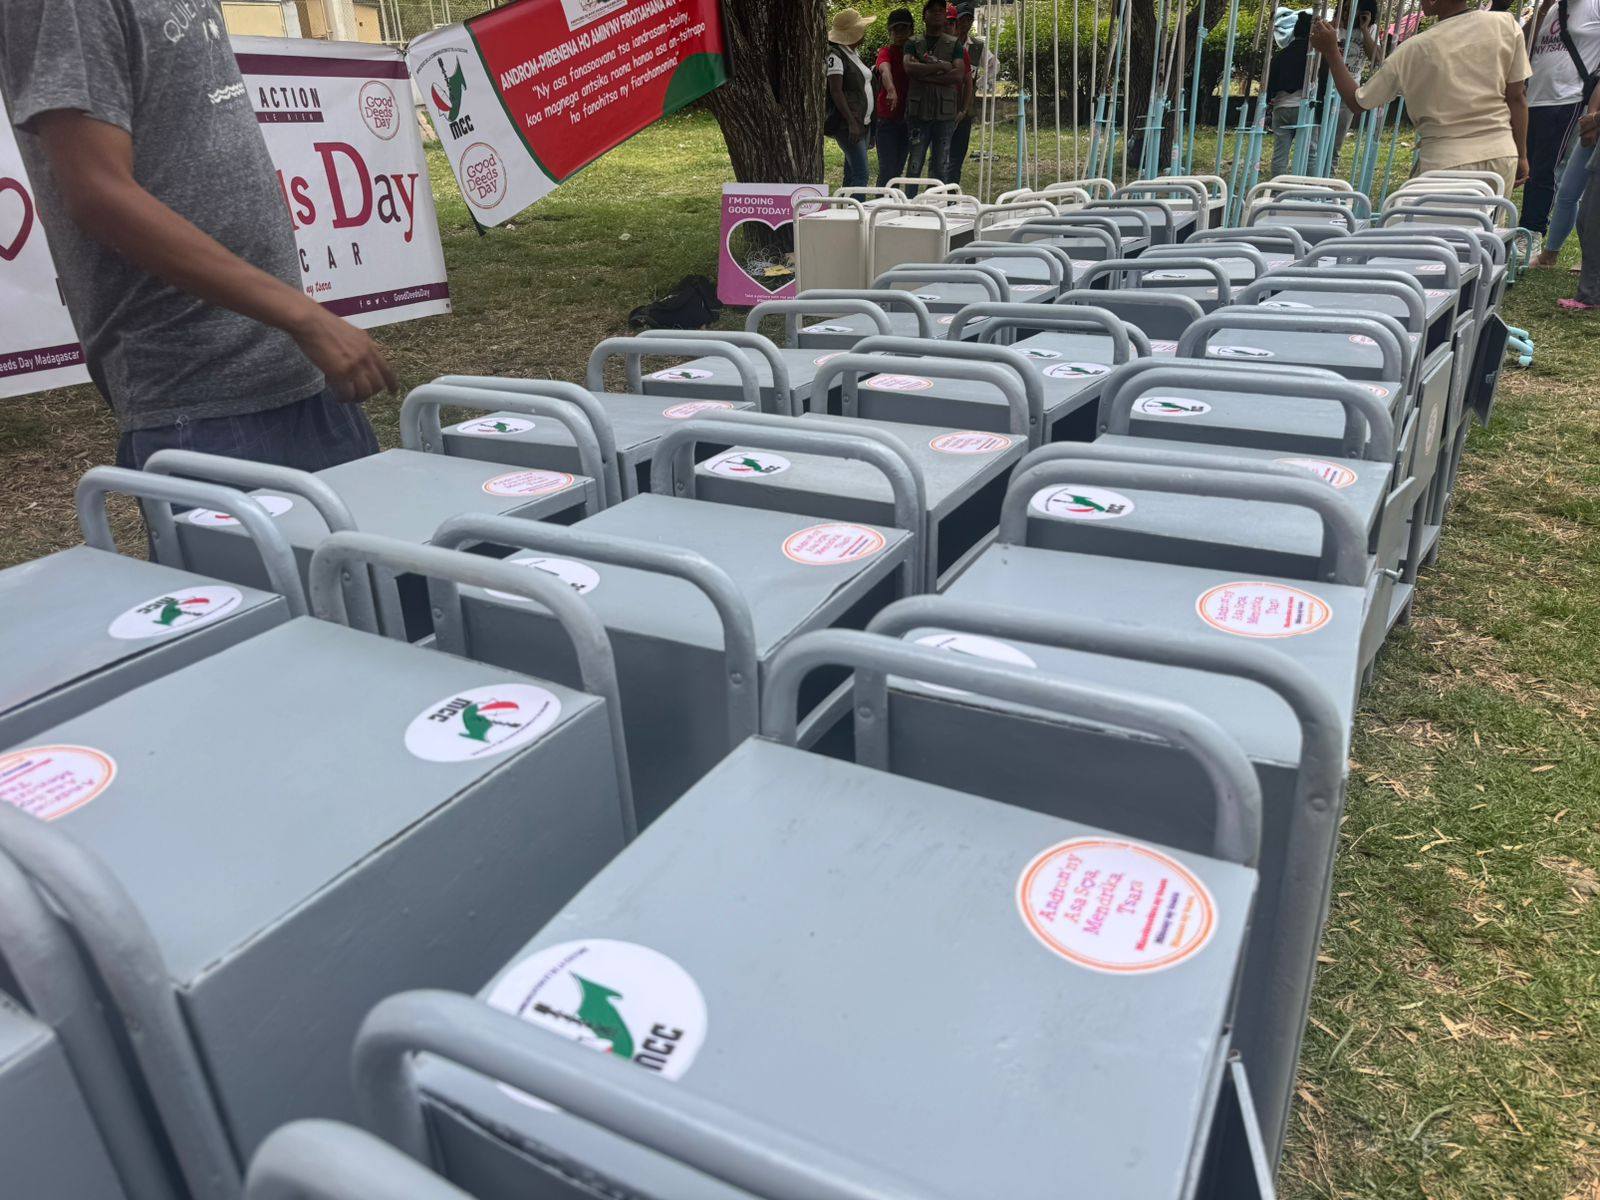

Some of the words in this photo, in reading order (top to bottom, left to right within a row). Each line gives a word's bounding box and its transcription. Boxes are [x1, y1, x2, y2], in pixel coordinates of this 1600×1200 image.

[577, 32, 591, 52] HO
[553, 75, 567, 91] asa
[617, 42, 630, 55] tsa
[525, 112, 542, 127] koa
[581, 73, 608, 97] antsika
[655, 43, 668, 56] asa
[258, 86, 321, 108] ACTION
[366, 96, 393, 108] Good
[569, 111, 581, 124] ho
[620, 84, 629, 98] ny
[365, 107, 393, 118] Deeds
[375, 117, 391, 129] Day
[466, 153, 497, 178] Good
[467, 170, 499, 192] Deeds
[477, 179, 499, 199] Day
[313, 142, 420, 243] Day
[744, 197, 774, 205] DOING
[728, 206, 755, 214] GOOD
[756, 207, 790, 215] TODAY!
[18, 357, 34, 370] Day
[34, 350, 80, 366] Madagascar
[1116, 880, 1144, 915] Tsara
